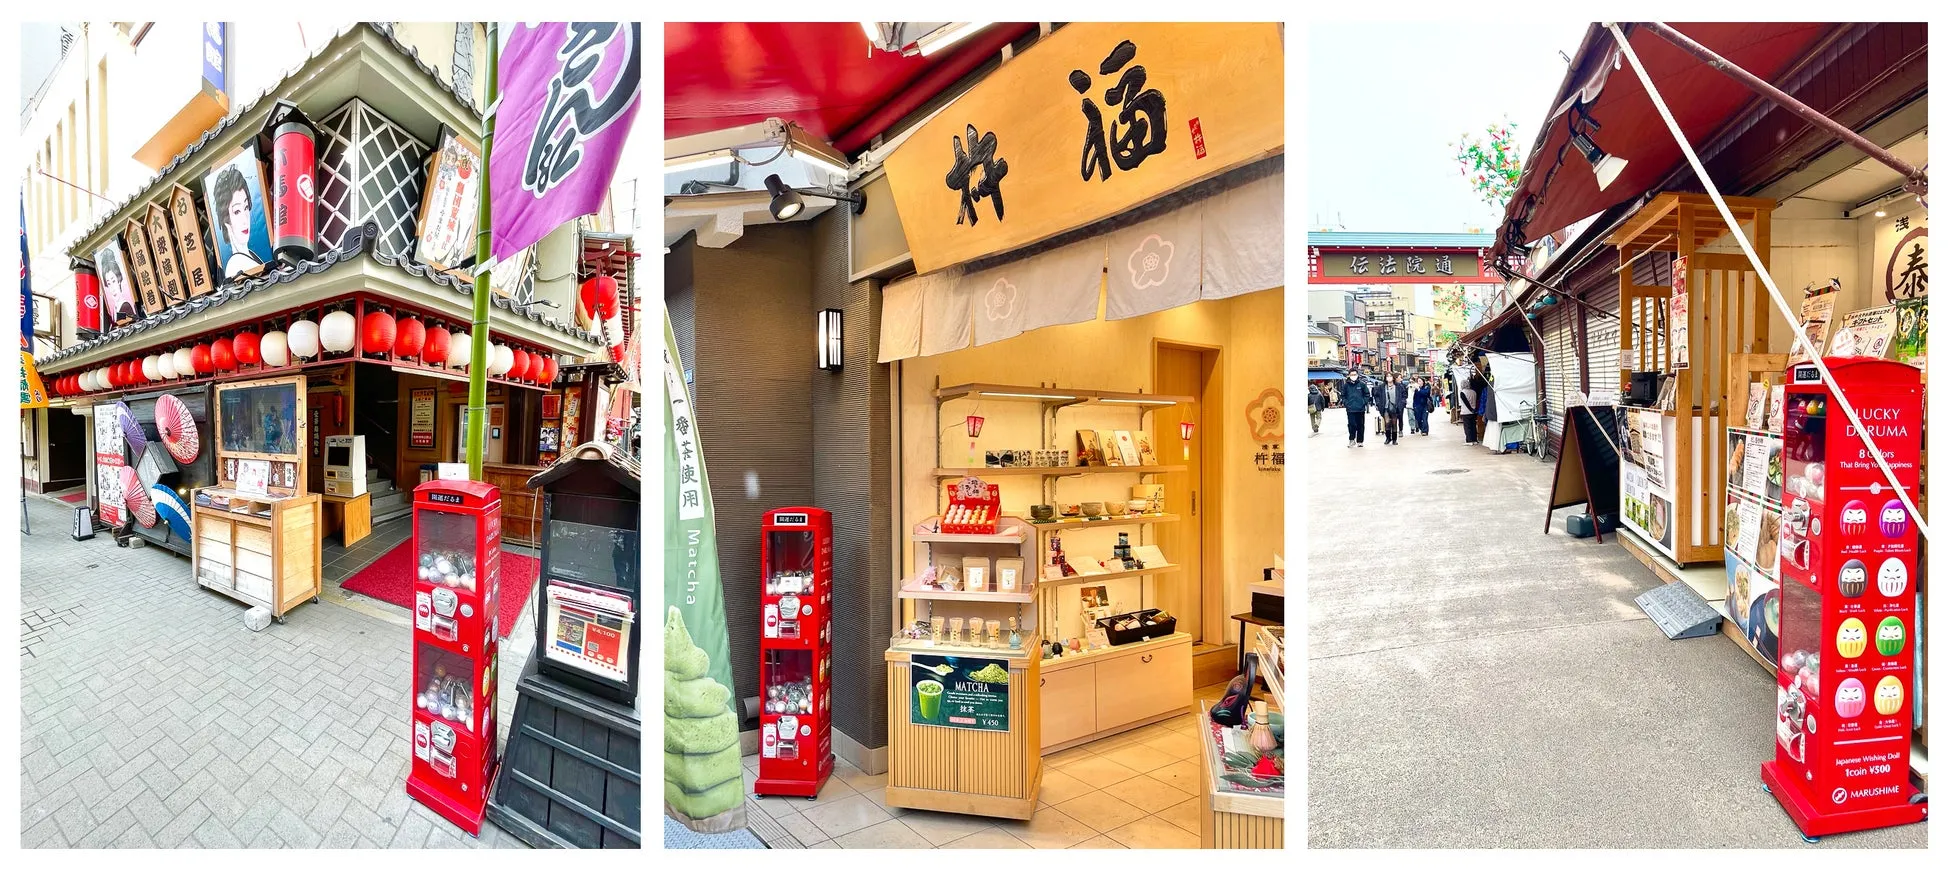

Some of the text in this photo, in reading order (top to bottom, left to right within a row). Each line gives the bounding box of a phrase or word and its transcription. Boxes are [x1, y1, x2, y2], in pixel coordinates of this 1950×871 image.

[176, 197, 205, 288] お芝居
[1350, 255, 1454, 275] 伝法院通
[1855, 408, 1900, 420] LUCKY
[1846, 425, 1908, 437] DRUMA
[1859, 449, 1895, 458] 8 Clors
[1854, 461, 1870, 470] Bring
[1885, 461, 1913, 470] appiness
[686, 529, 701, 605] Matcha
[955, 681, 990, 693] MATCHA
[960, 705, 975, 714] 抹茶
[1836, 752, 1901, 767] Japanese Wishing Doll
[1845, 764, 1891, 777] 1coin ¥500
[1850, 785, 1900, 798] MARUSHIME
